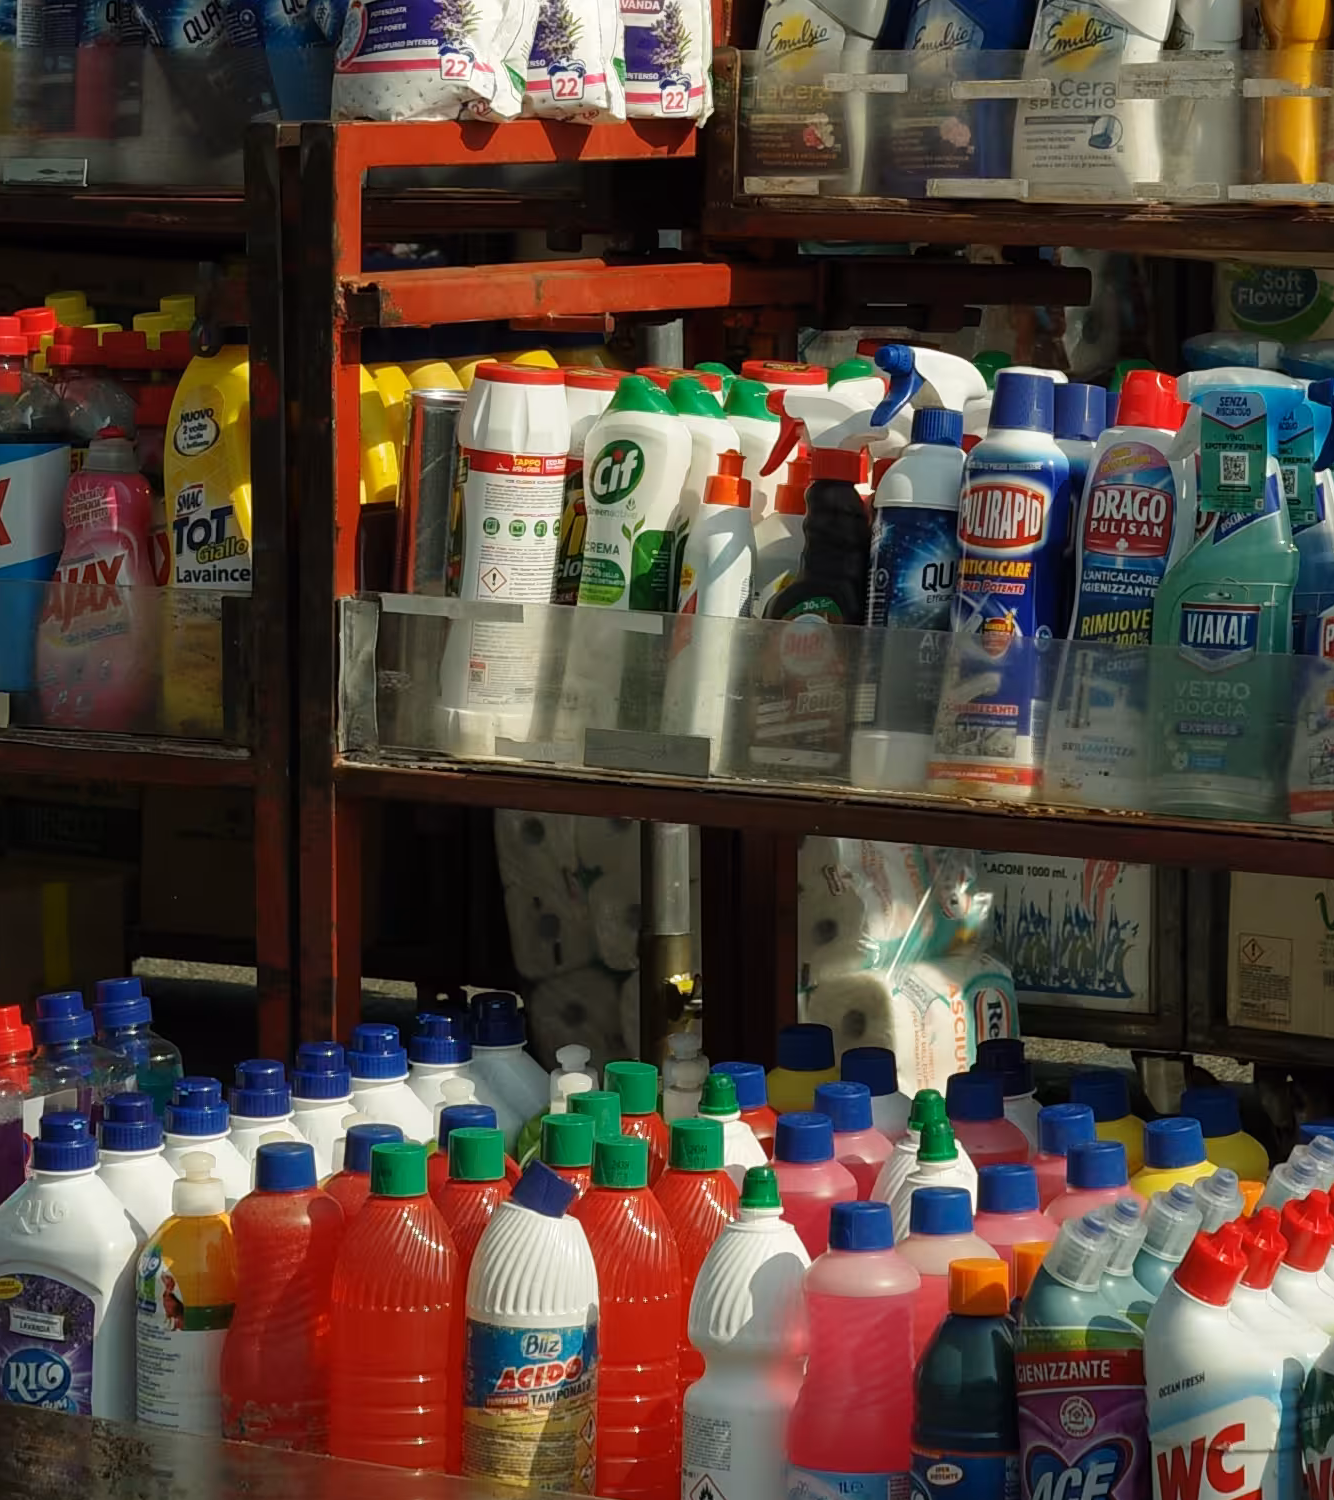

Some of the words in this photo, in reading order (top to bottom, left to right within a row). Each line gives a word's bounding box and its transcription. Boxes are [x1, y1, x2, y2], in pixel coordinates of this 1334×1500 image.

[765, 19, 831, 55] Emulsio
[1043, 17, 1114, 53] Emulsio
[373, 41, 406, 52] PROFUMO
[444, 58, 468, 80] 22
[555, 77, 580, 98] 22
[665, 91, 684, 111] 22
[1028, 96, 1117, 112] SPECCHIO
[1261, 271, 1303, 293] Soft
[1237, 287, 1305, 307] Flower
[1217, 394, 1249, 409] SENZA
[180, 409, 215, 425] NUOVO
[1204, 441, 1232, 451] SPOTIFY
[1224, 433, 1246, 442] VINCI
[592, 449, 638, 497] Cif
[176, 488, 205, 513] SMAC
[1090, 489, 1168, 525] DRAGO
[172, 505, 234, 557] TOT
[1088, 519, 1165, 539] PULISAN
[196, 536, 249, 565] Giallo
[175, 564, 251, 585] Lavaince
[1082, 569, 1162, 588] L'ANTICALCARE
[979, 581, 1026, 597] POTENTE
[1081, 581, 1159, 598] IGIENIZZANTE
[1080, 608, 1152, 637] RIMUOVE
[1184, 608, 1251, 649] VIAKAL
[1174, 679, 1251, 701] VETRO
[1173, 698, 1247, 718] DOCCIA
[1026, 865, 1050, 878] 1000
[524, 1334, 560, 1358] Bliz
[8, 1360, 66, 1403] RIO
[495, 1356, 584, 1394] ACIDO
[1158, 1382, 1181, 1400] OCEAN
[1181, 1371, 1205, 1393] FRESH
[530, 1383, 592, 1408] TAMPONATO
